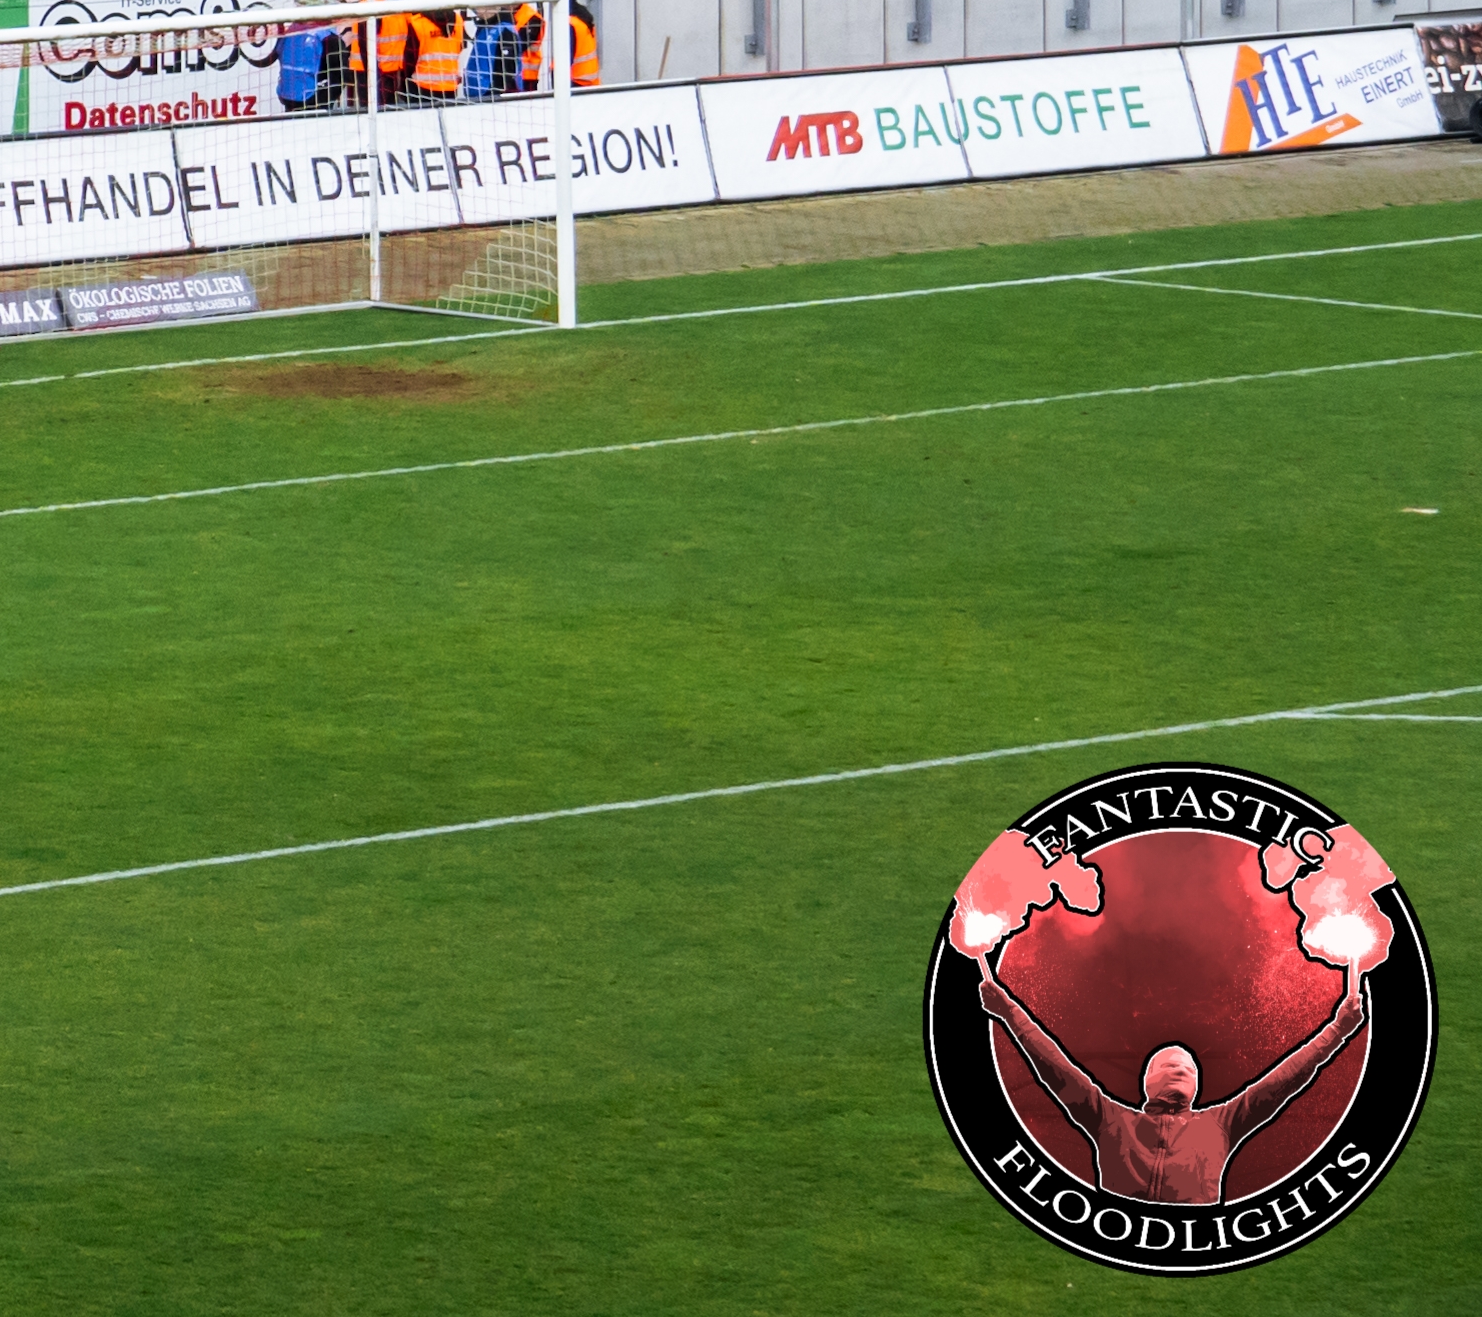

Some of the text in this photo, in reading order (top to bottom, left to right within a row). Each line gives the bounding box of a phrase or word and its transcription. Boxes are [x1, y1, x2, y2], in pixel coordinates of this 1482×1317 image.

[1334, 48, 1408, 90] HAUSTECHNIK
[1360, 67, 1416, 105] EINERT
[64, 91, 258, 131] Datenschutz
[1235, 42, 1338, 149] HTE
[1395, 88, 1425, 110] GmbH
[765, 85, 1151, 162] MTB BAUSTOFFE
[250, 157, 298, 208] IN
[312, 144, 484, 203] DEINER
[494, 124, 679, 185] REGION!
[67, 275, 245, 310] ÖKOLOGISCHE FOLIEN
[77, 311, 99, 324] CWS
[194, 297, 236, 312] SACHSEN
[236, 296, 251, 308] AG
